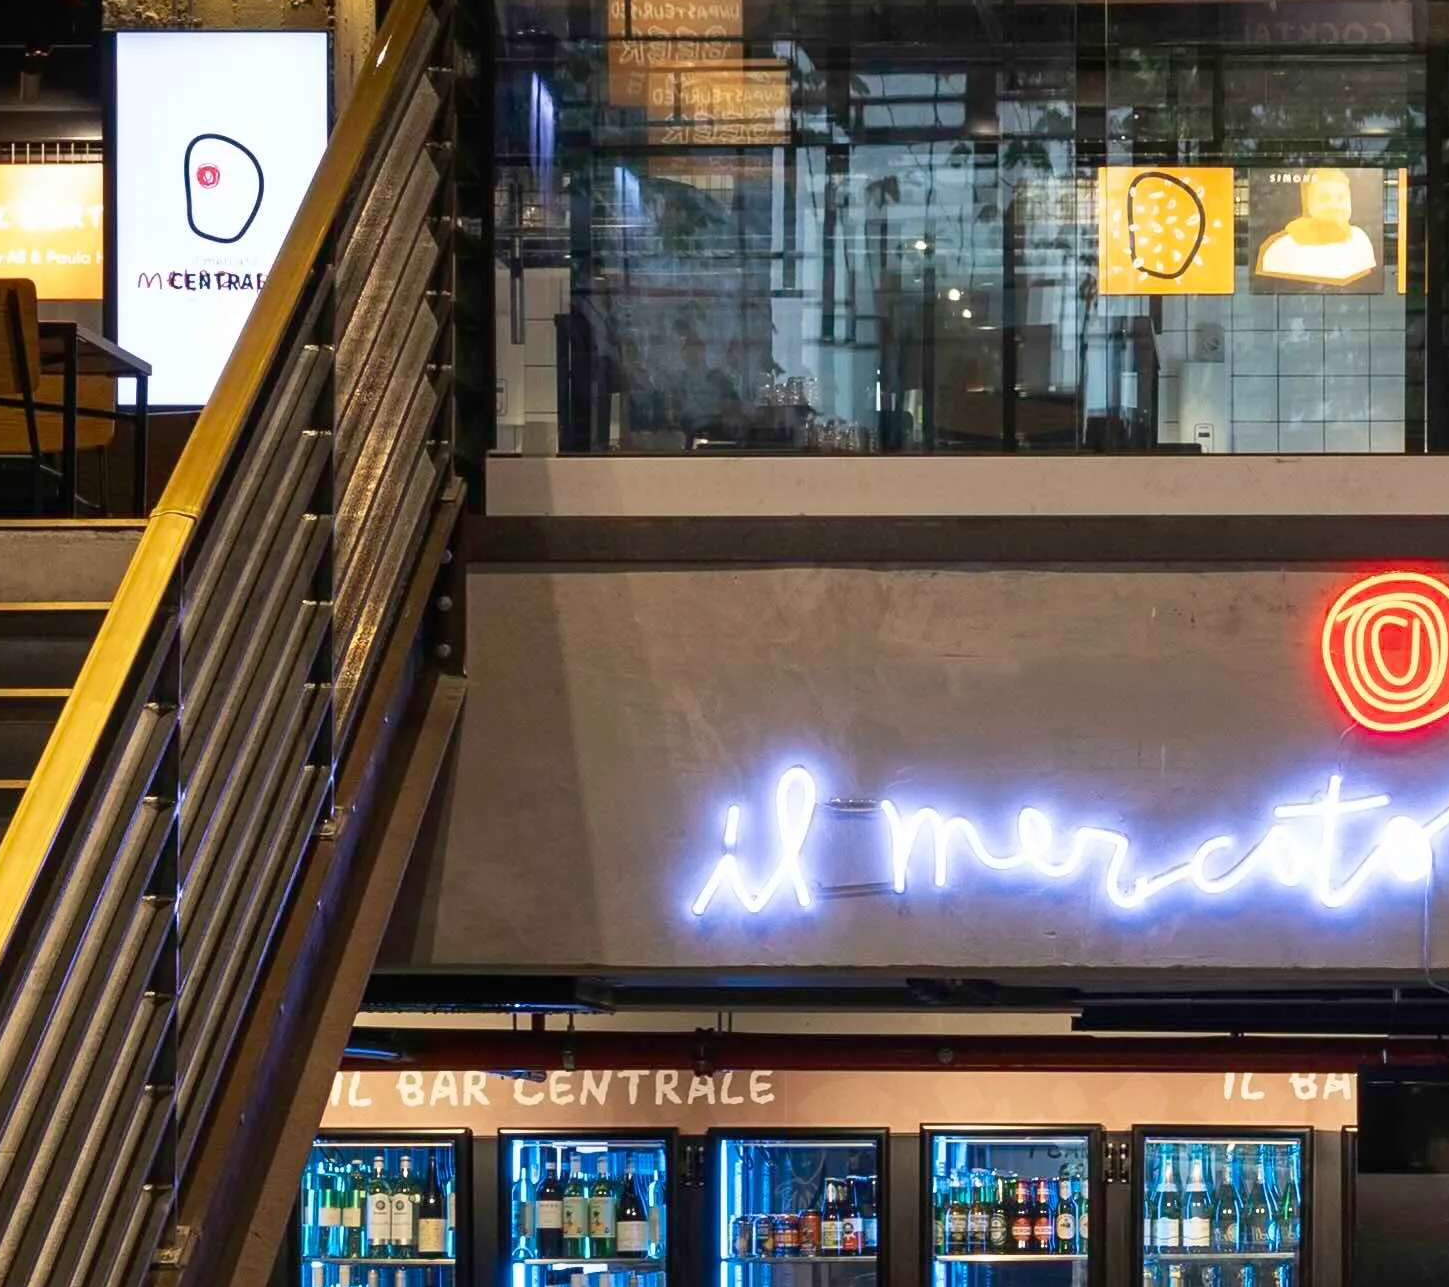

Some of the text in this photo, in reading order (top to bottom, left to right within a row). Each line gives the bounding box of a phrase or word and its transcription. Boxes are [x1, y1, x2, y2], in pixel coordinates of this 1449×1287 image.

[692, 762, 820, 918] il
[331, 1069, 777, 1108] IL BAR CENTRALE
[1222, 1072, 1352, 1101] IL BA
